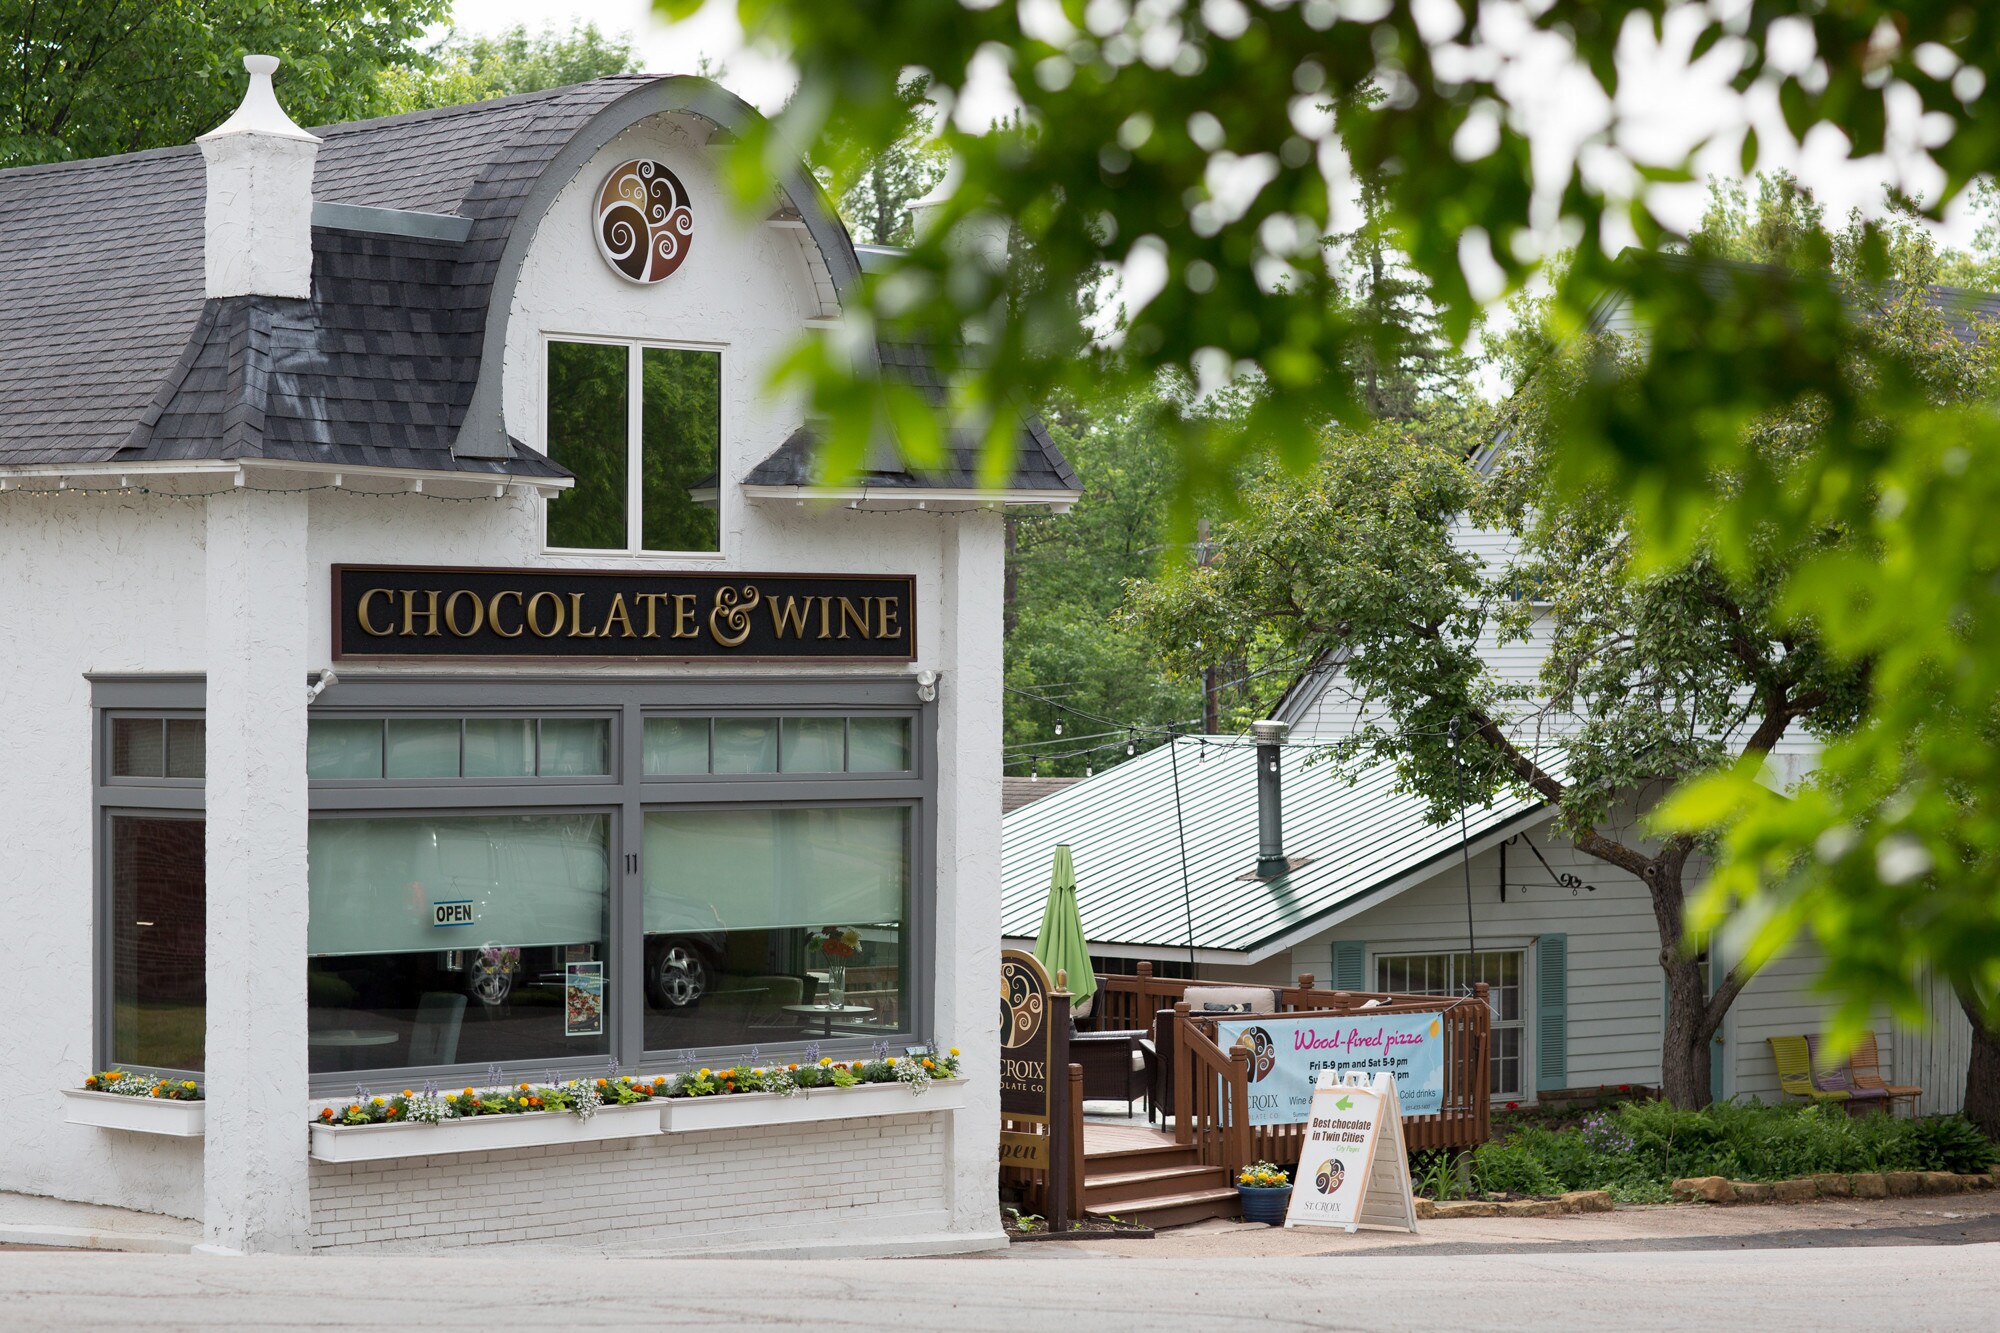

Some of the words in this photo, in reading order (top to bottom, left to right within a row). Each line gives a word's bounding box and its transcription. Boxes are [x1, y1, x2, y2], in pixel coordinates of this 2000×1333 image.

[357, 588, 700, 638] CHOCOLATE
[708, 585, 760, 647] &
[764, 595, 902, 639] WINE
[436, 904, 472, 922] OPEN
[1294, 1027, 1383, 1054] Wood-fired
[1383, 1030, 1424, 1056] pizza
[1309, 1061, 1321, 1071] Fri
[1322, 1060, 1336, 1070] 5-9
[1337, 1062, 1350, 1071] pm
[1351, 1059, 1366, 1068] and
[1368, 1058, 1381, 1067] Sat
[1382, 1057, 1395, 1066] 5-9
[1396, 1057, 1408, 1068] pm
[1397, 1071, 1409, 1081] pm
[1288, 1096, 1307, 1105] Wine
[1400, 1090, 1415, 1099] Cold
[1416, 1089, 1436, 1098] drinks
[1312, 1117, 1332, 1129] Best
[1331, 1119, 1372, 1130] chocolate
[1312, 1131, 1321, 1141] in
[1322, 1131, 1341, 1141] Twin
[1341, 1132, 1365, 1143] Cities
